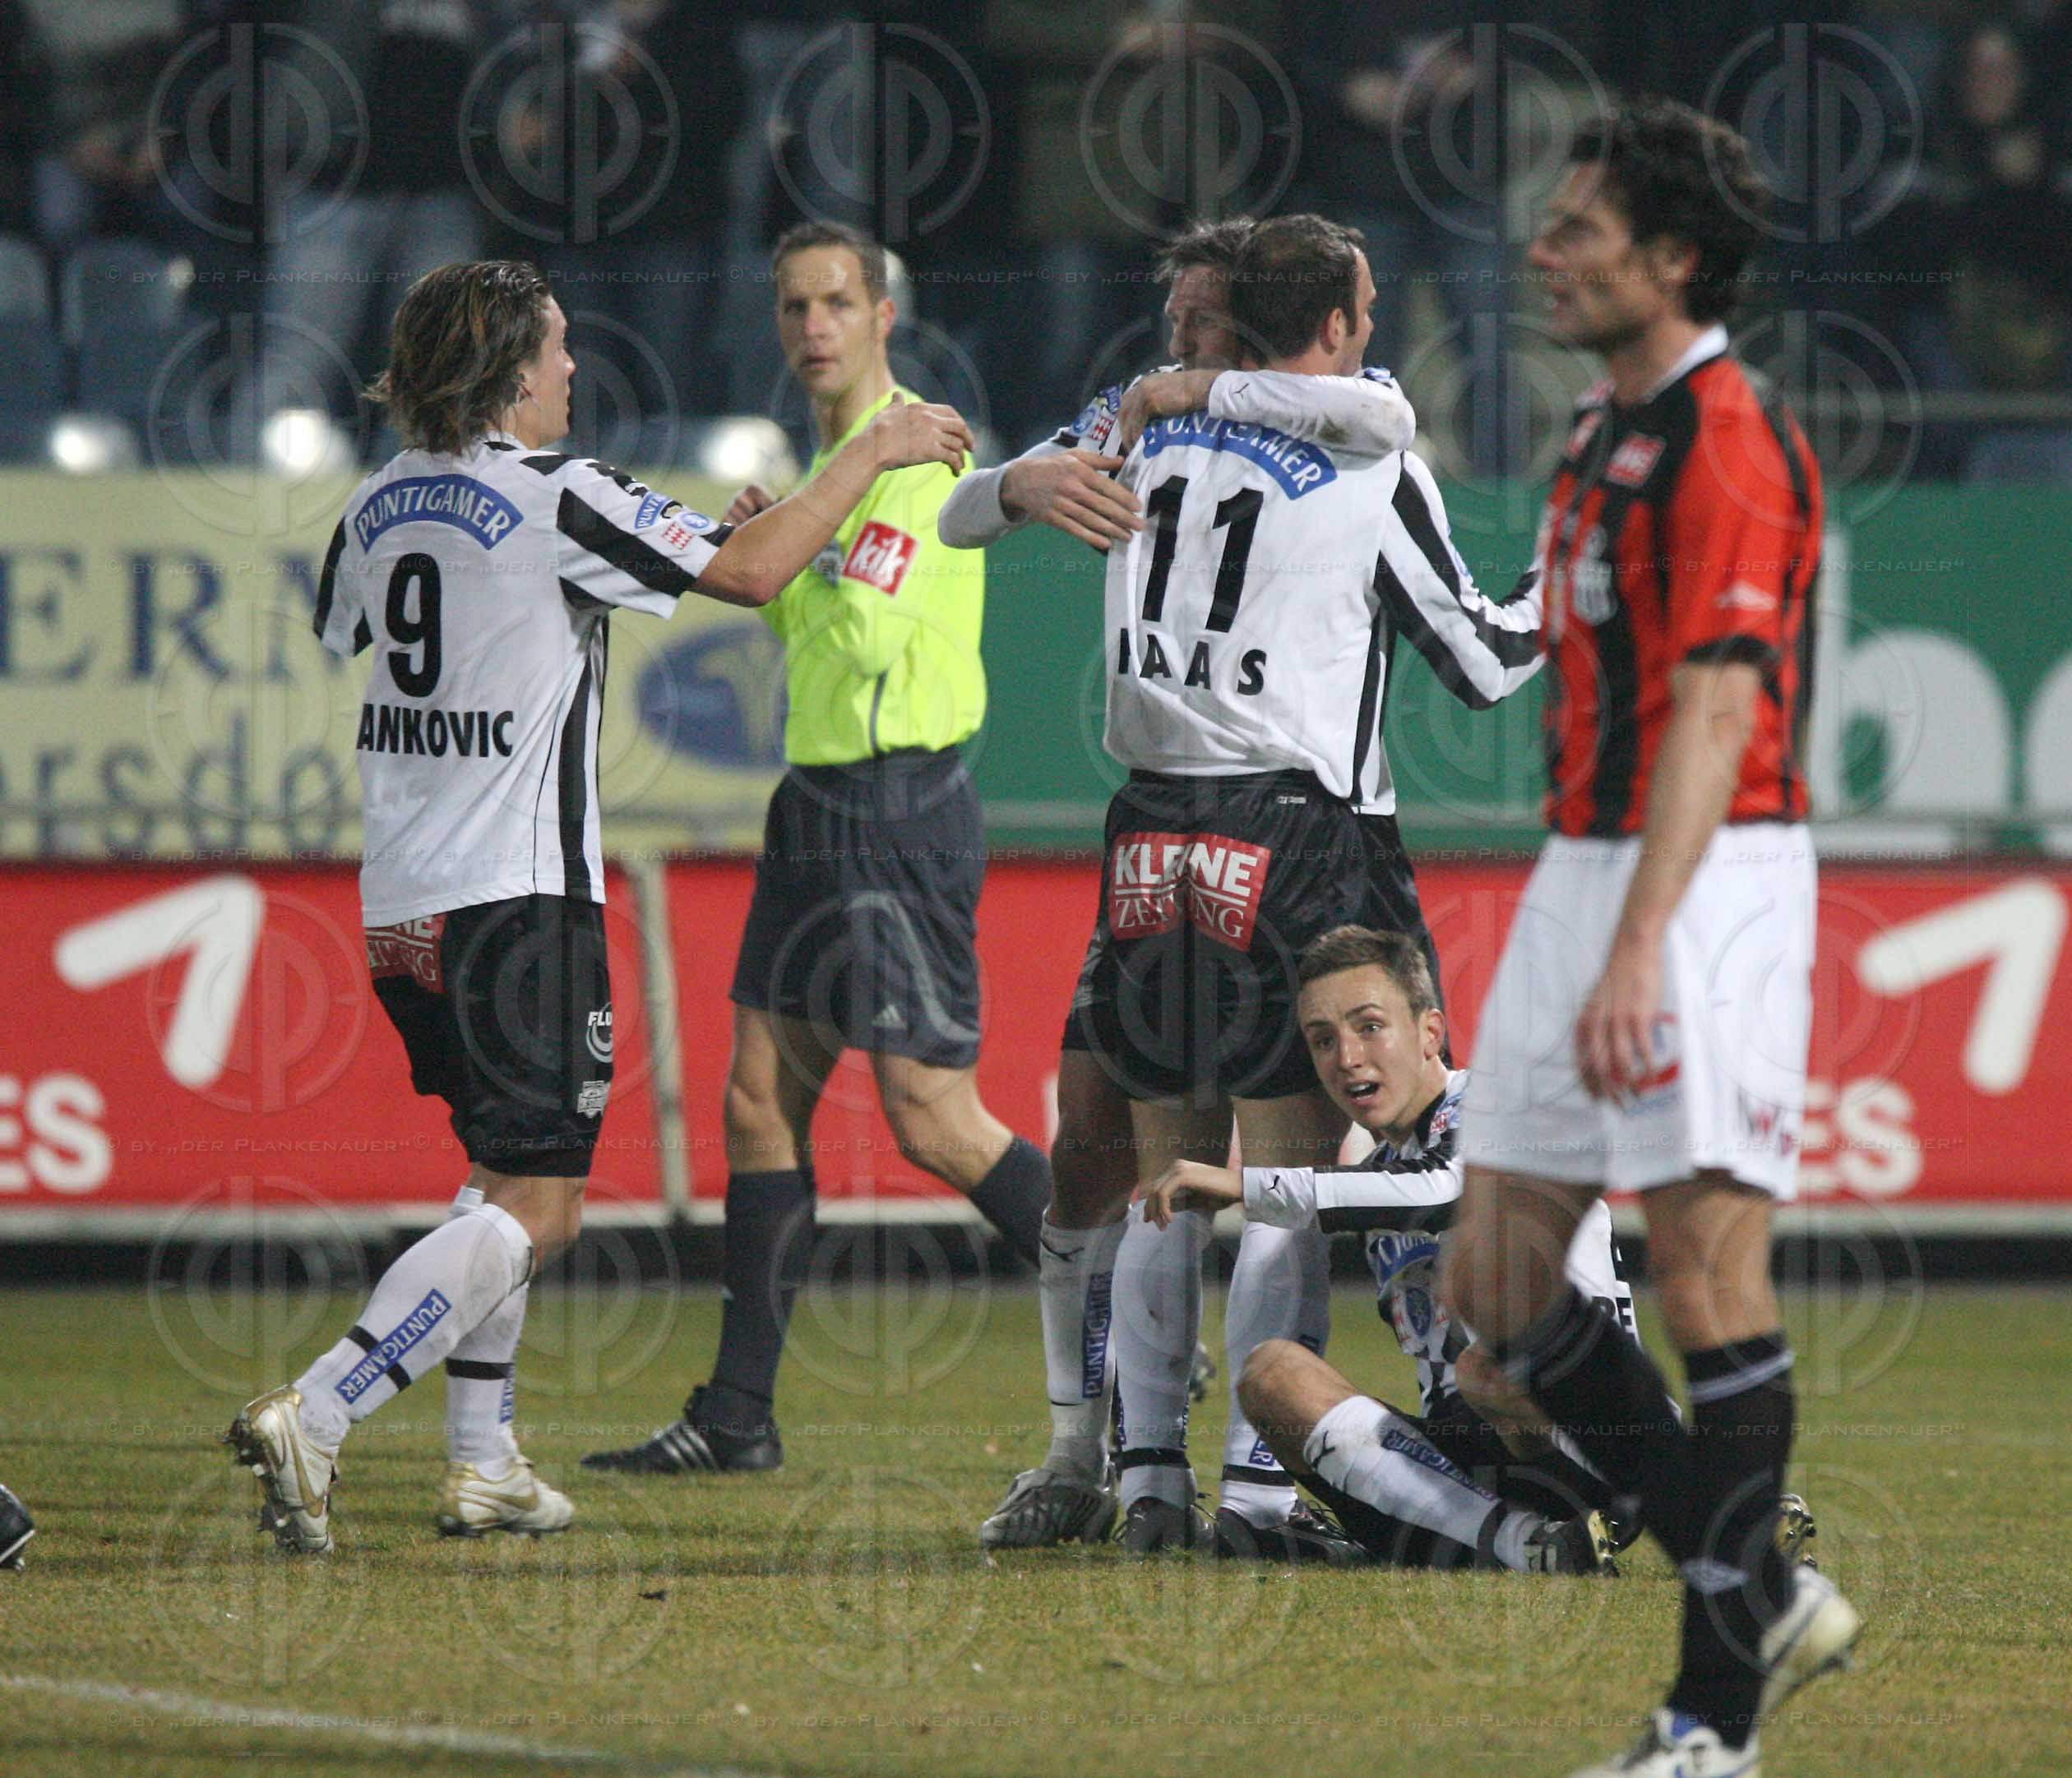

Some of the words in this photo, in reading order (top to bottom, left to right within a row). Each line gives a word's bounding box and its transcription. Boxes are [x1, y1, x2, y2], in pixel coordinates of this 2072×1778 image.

[359, 483, 511, 544] PUNTIGAMER
[1142, 474, 1264, 633] 11
[849, 529, 905, 587] kik
[386, 552, 442, 697] 9
[357, 704, 513, 757] ANKOVIC
[339, 1294, 447, 1397] PUNTIGAMER
